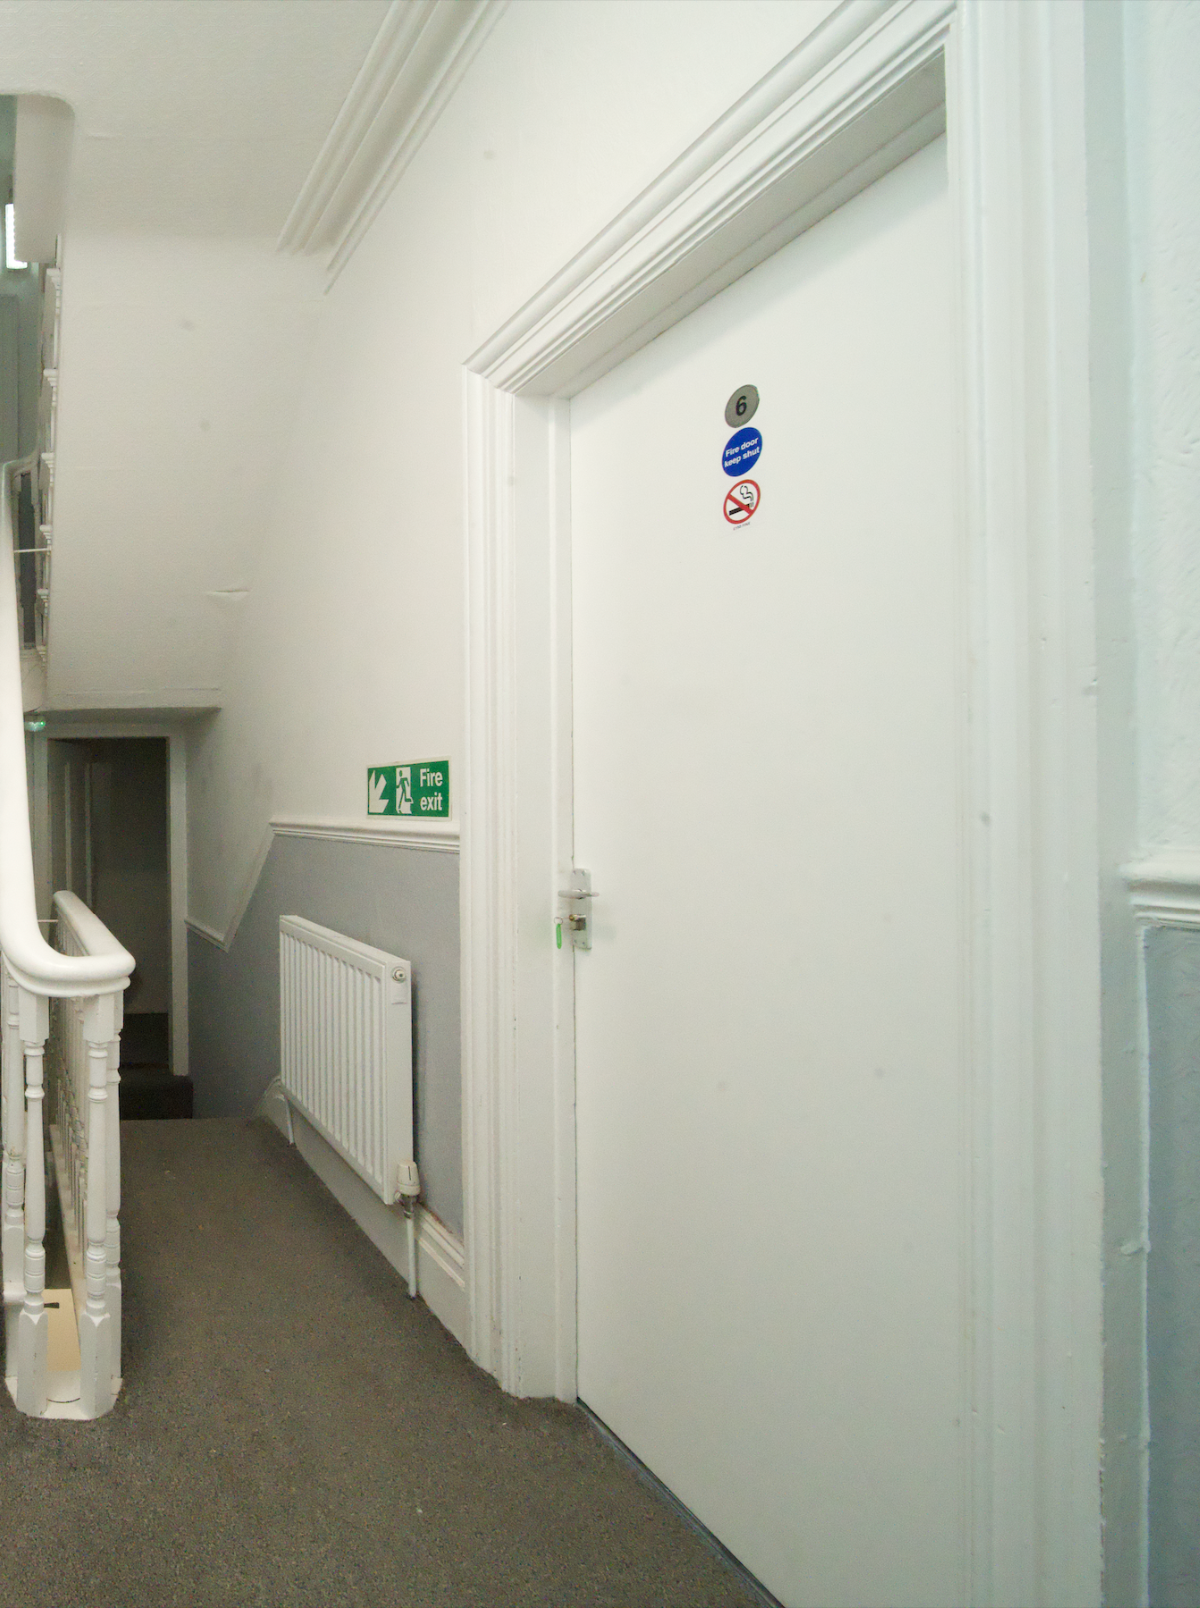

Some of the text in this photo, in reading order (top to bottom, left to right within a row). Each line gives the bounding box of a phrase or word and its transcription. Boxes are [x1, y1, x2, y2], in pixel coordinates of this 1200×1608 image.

[735, 395, 748, 416] 6
[724, 446, 760, 468] keep shut
[725, 437, 759, 457] Fire door
[419, 768, 443, 787] Fire
[420, 791, 443, 811] exit
